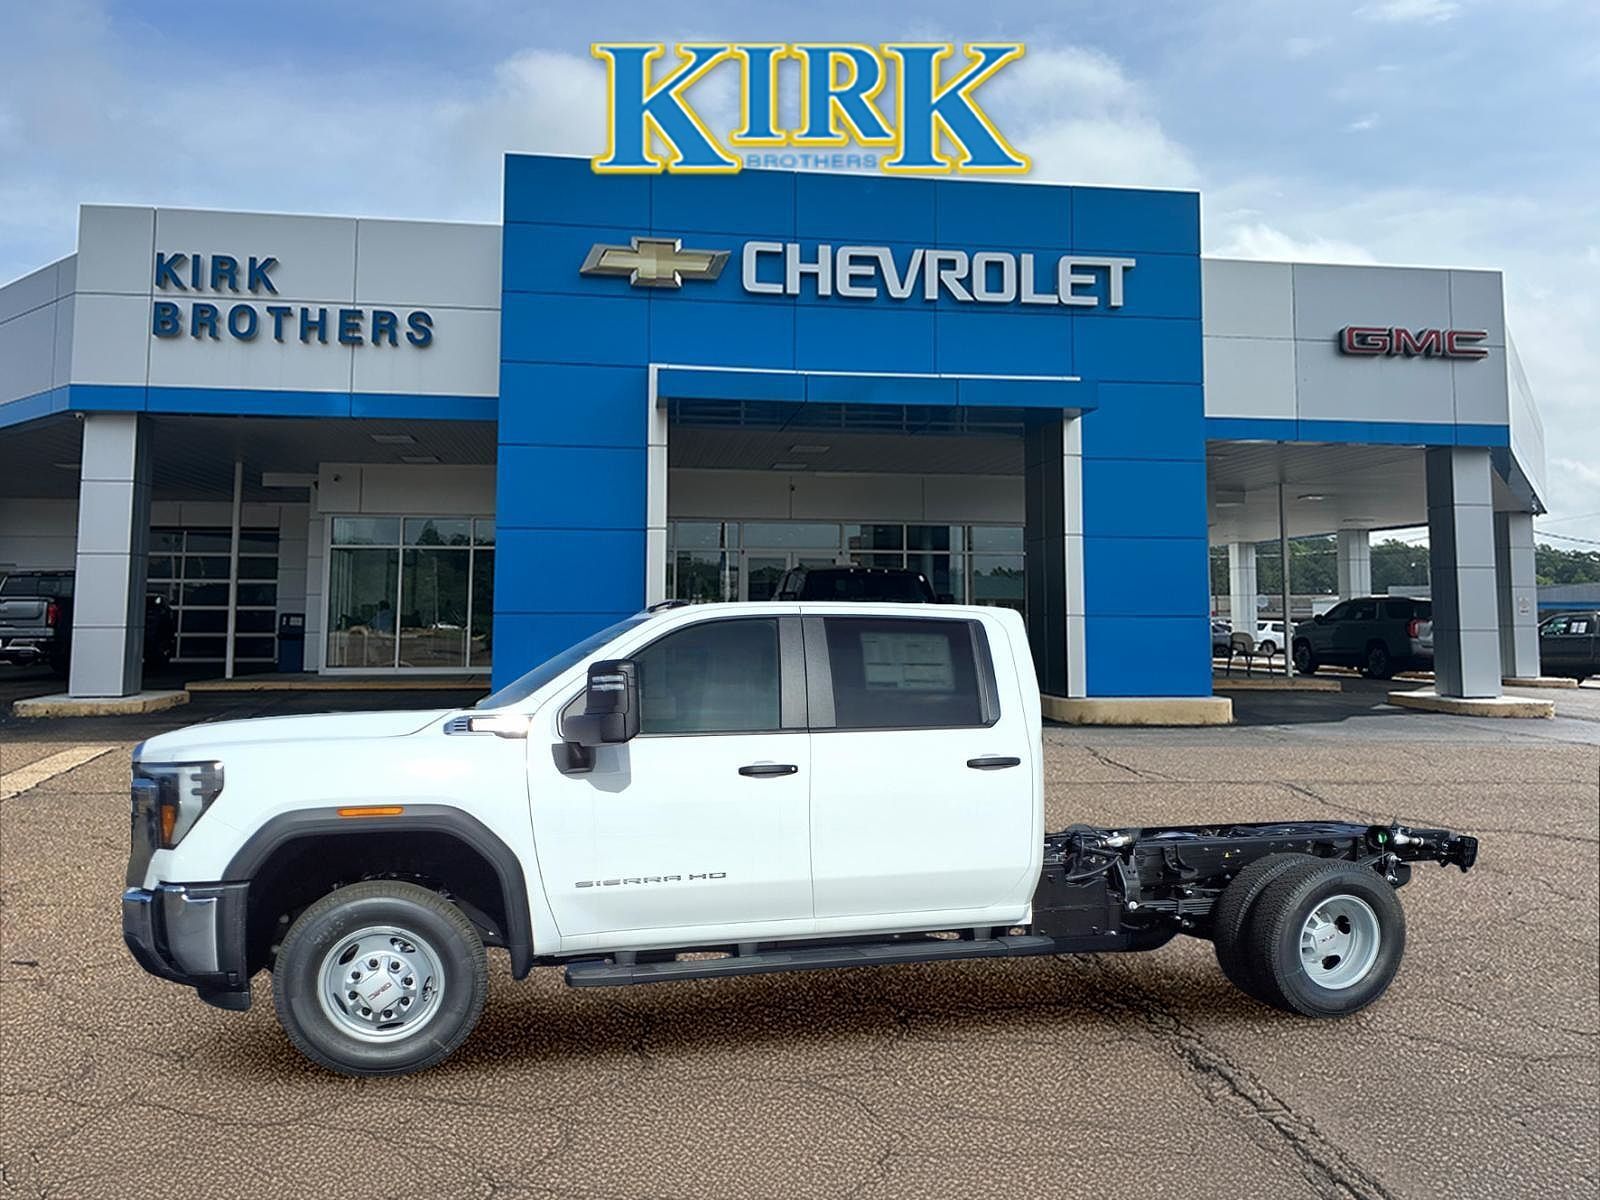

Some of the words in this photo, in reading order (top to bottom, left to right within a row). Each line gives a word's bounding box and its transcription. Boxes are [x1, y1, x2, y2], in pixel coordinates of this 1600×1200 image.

[154, 251, 280, 295] KIRK
[742, 240, 1137, 307] CHEVROLET
[152, 300, 434, 347] BROTHERS
[1341, 325, 1489, 359] GMC
[575, 874, 682, 888] SIERRA
[689, 872, 726, 880] HD
